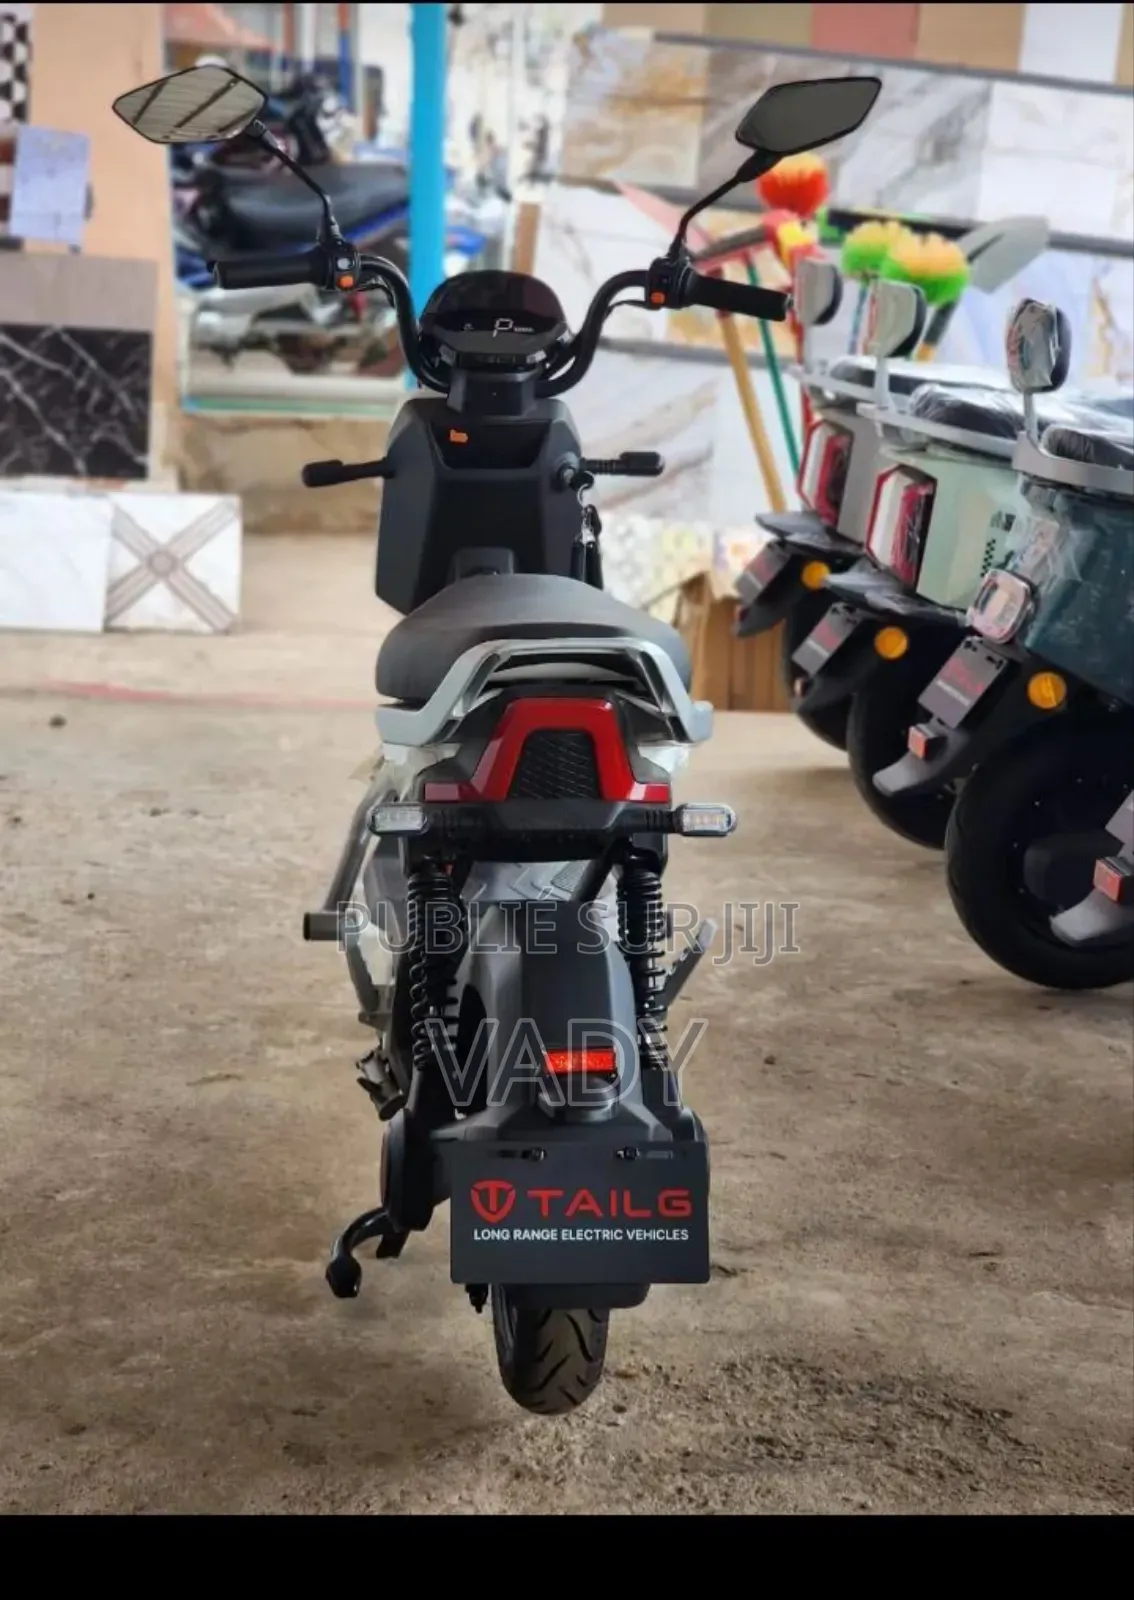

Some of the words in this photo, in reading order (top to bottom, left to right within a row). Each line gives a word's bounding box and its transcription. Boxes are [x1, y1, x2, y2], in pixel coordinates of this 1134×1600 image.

[526, 1188, 692, 1218] TAILG
[473, 1228, 511, 1241] LONG
[512, 1228, 559, 1241] RANGE
[561, 1228, 624, 1241] ELECTRIC
[626, 1228, 690, 1241] VEHICLES
